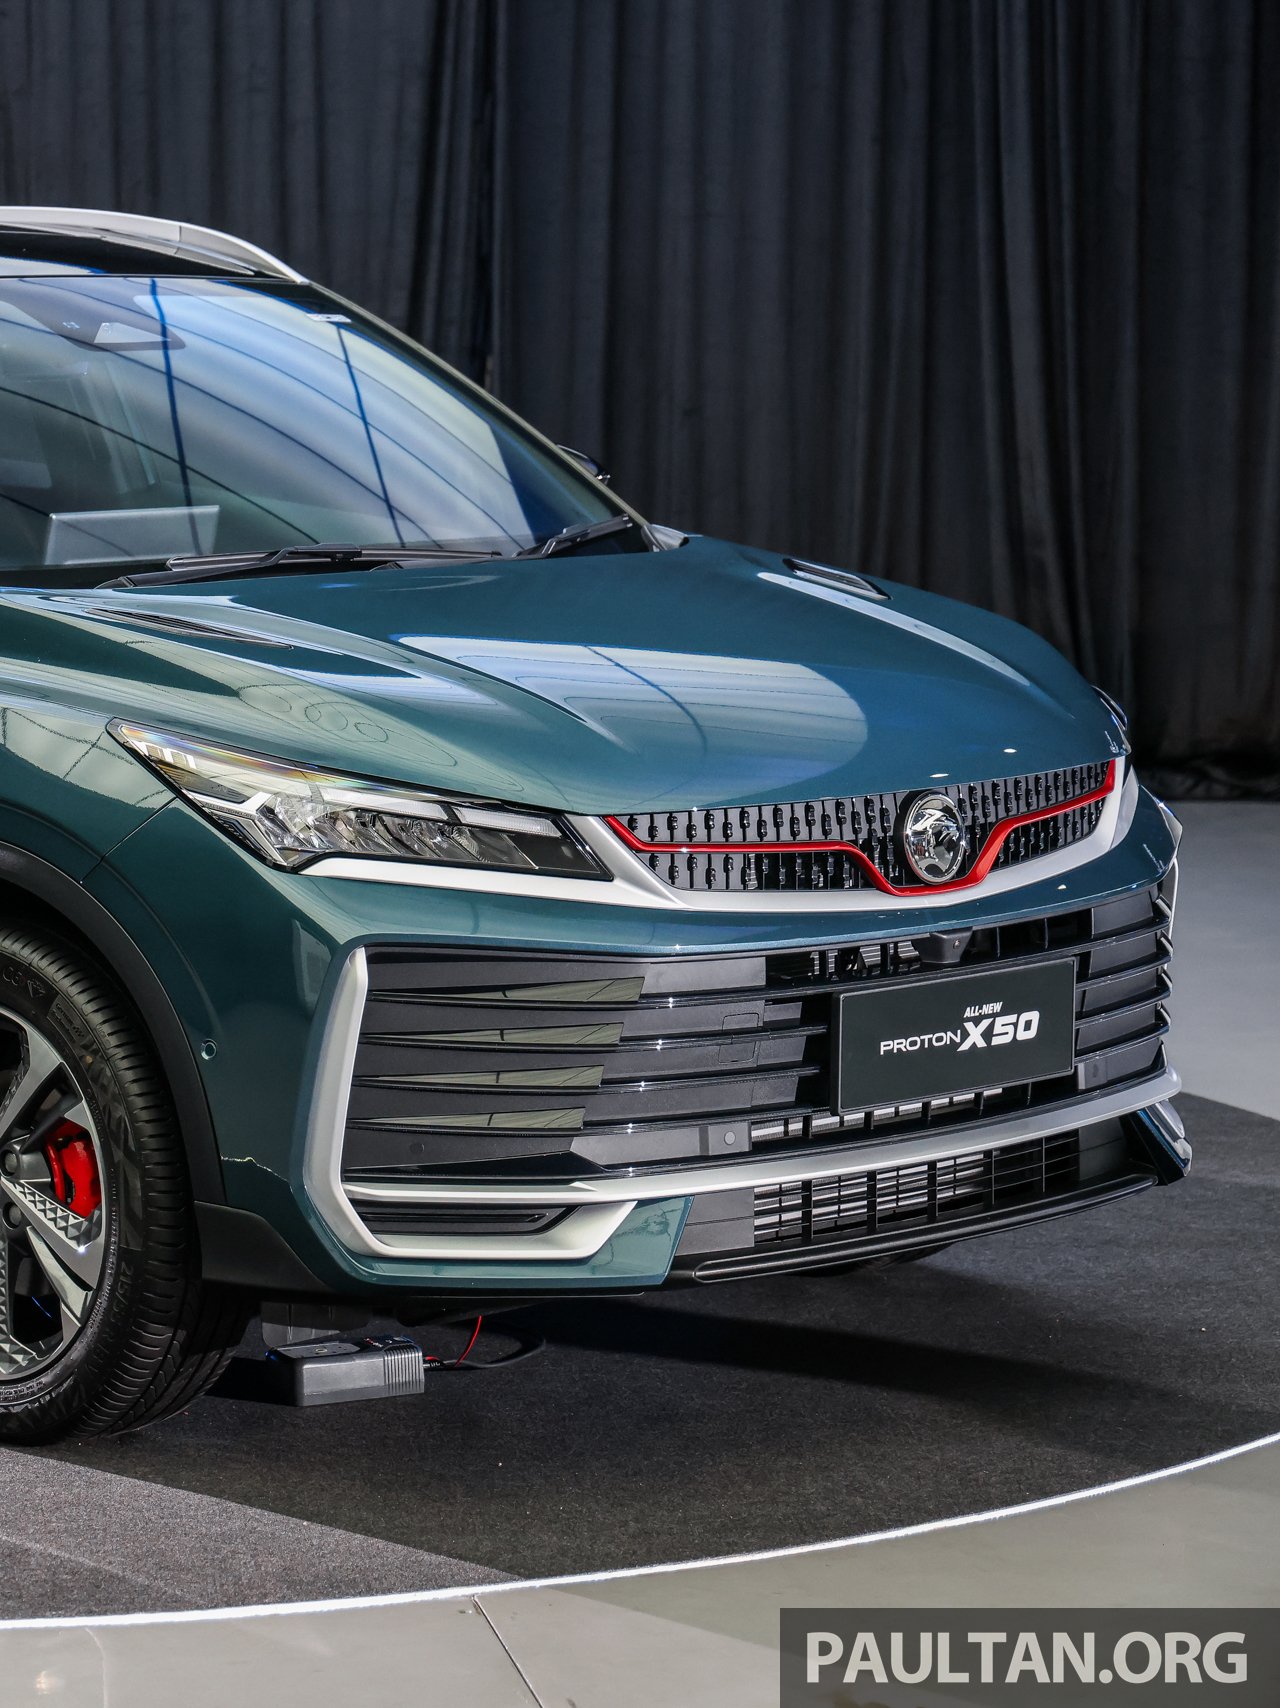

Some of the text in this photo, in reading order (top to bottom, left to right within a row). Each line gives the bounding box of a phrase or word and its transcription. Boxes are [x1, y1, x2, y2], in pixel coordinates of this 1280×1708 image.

[963, 1001, 1003, 1018] ALL-NEW
[880, 1010, 1040, 1055] PROTON X50
